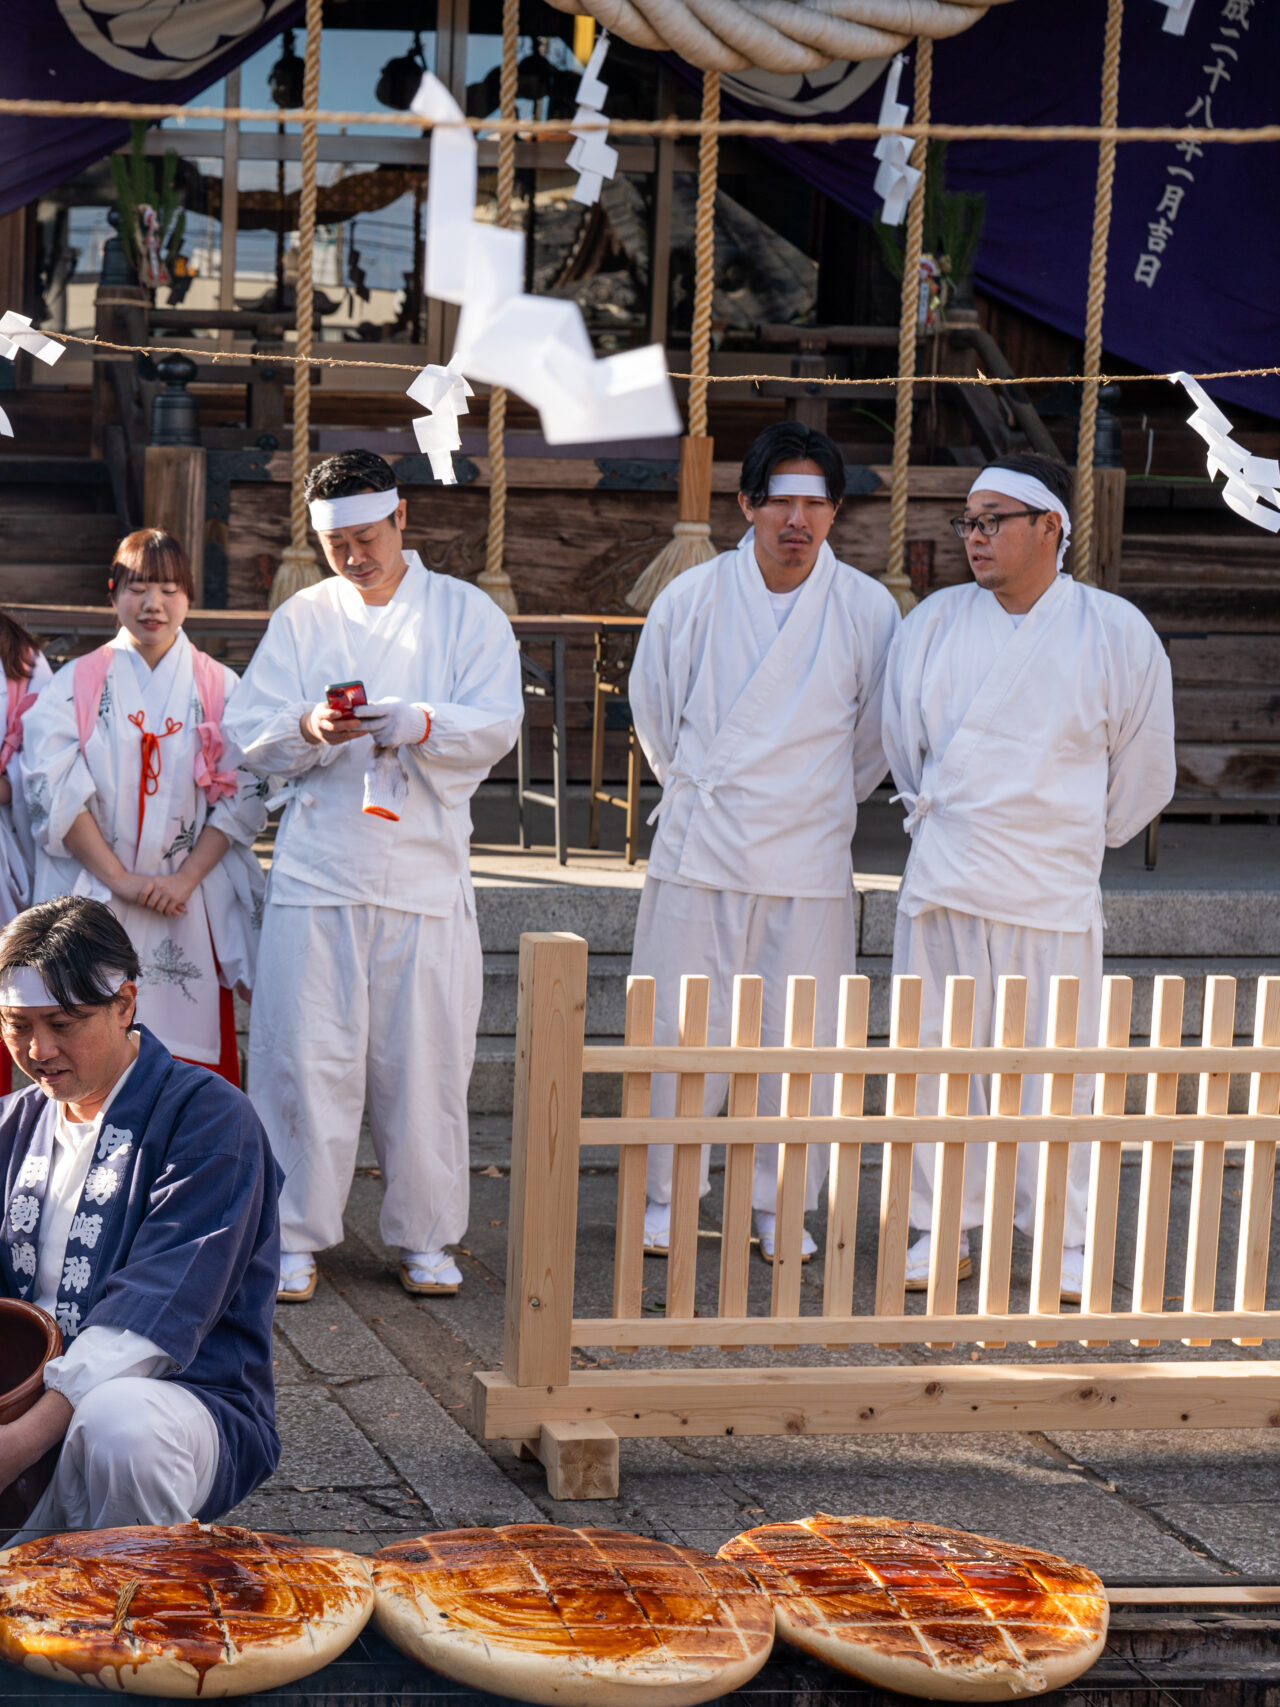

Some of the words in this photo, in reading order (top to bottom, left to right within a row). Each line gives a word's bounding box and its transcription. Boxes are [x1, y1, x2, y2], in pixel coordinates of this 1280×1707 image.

[56, 1123, 133, 1338] 伊勢崎神社
